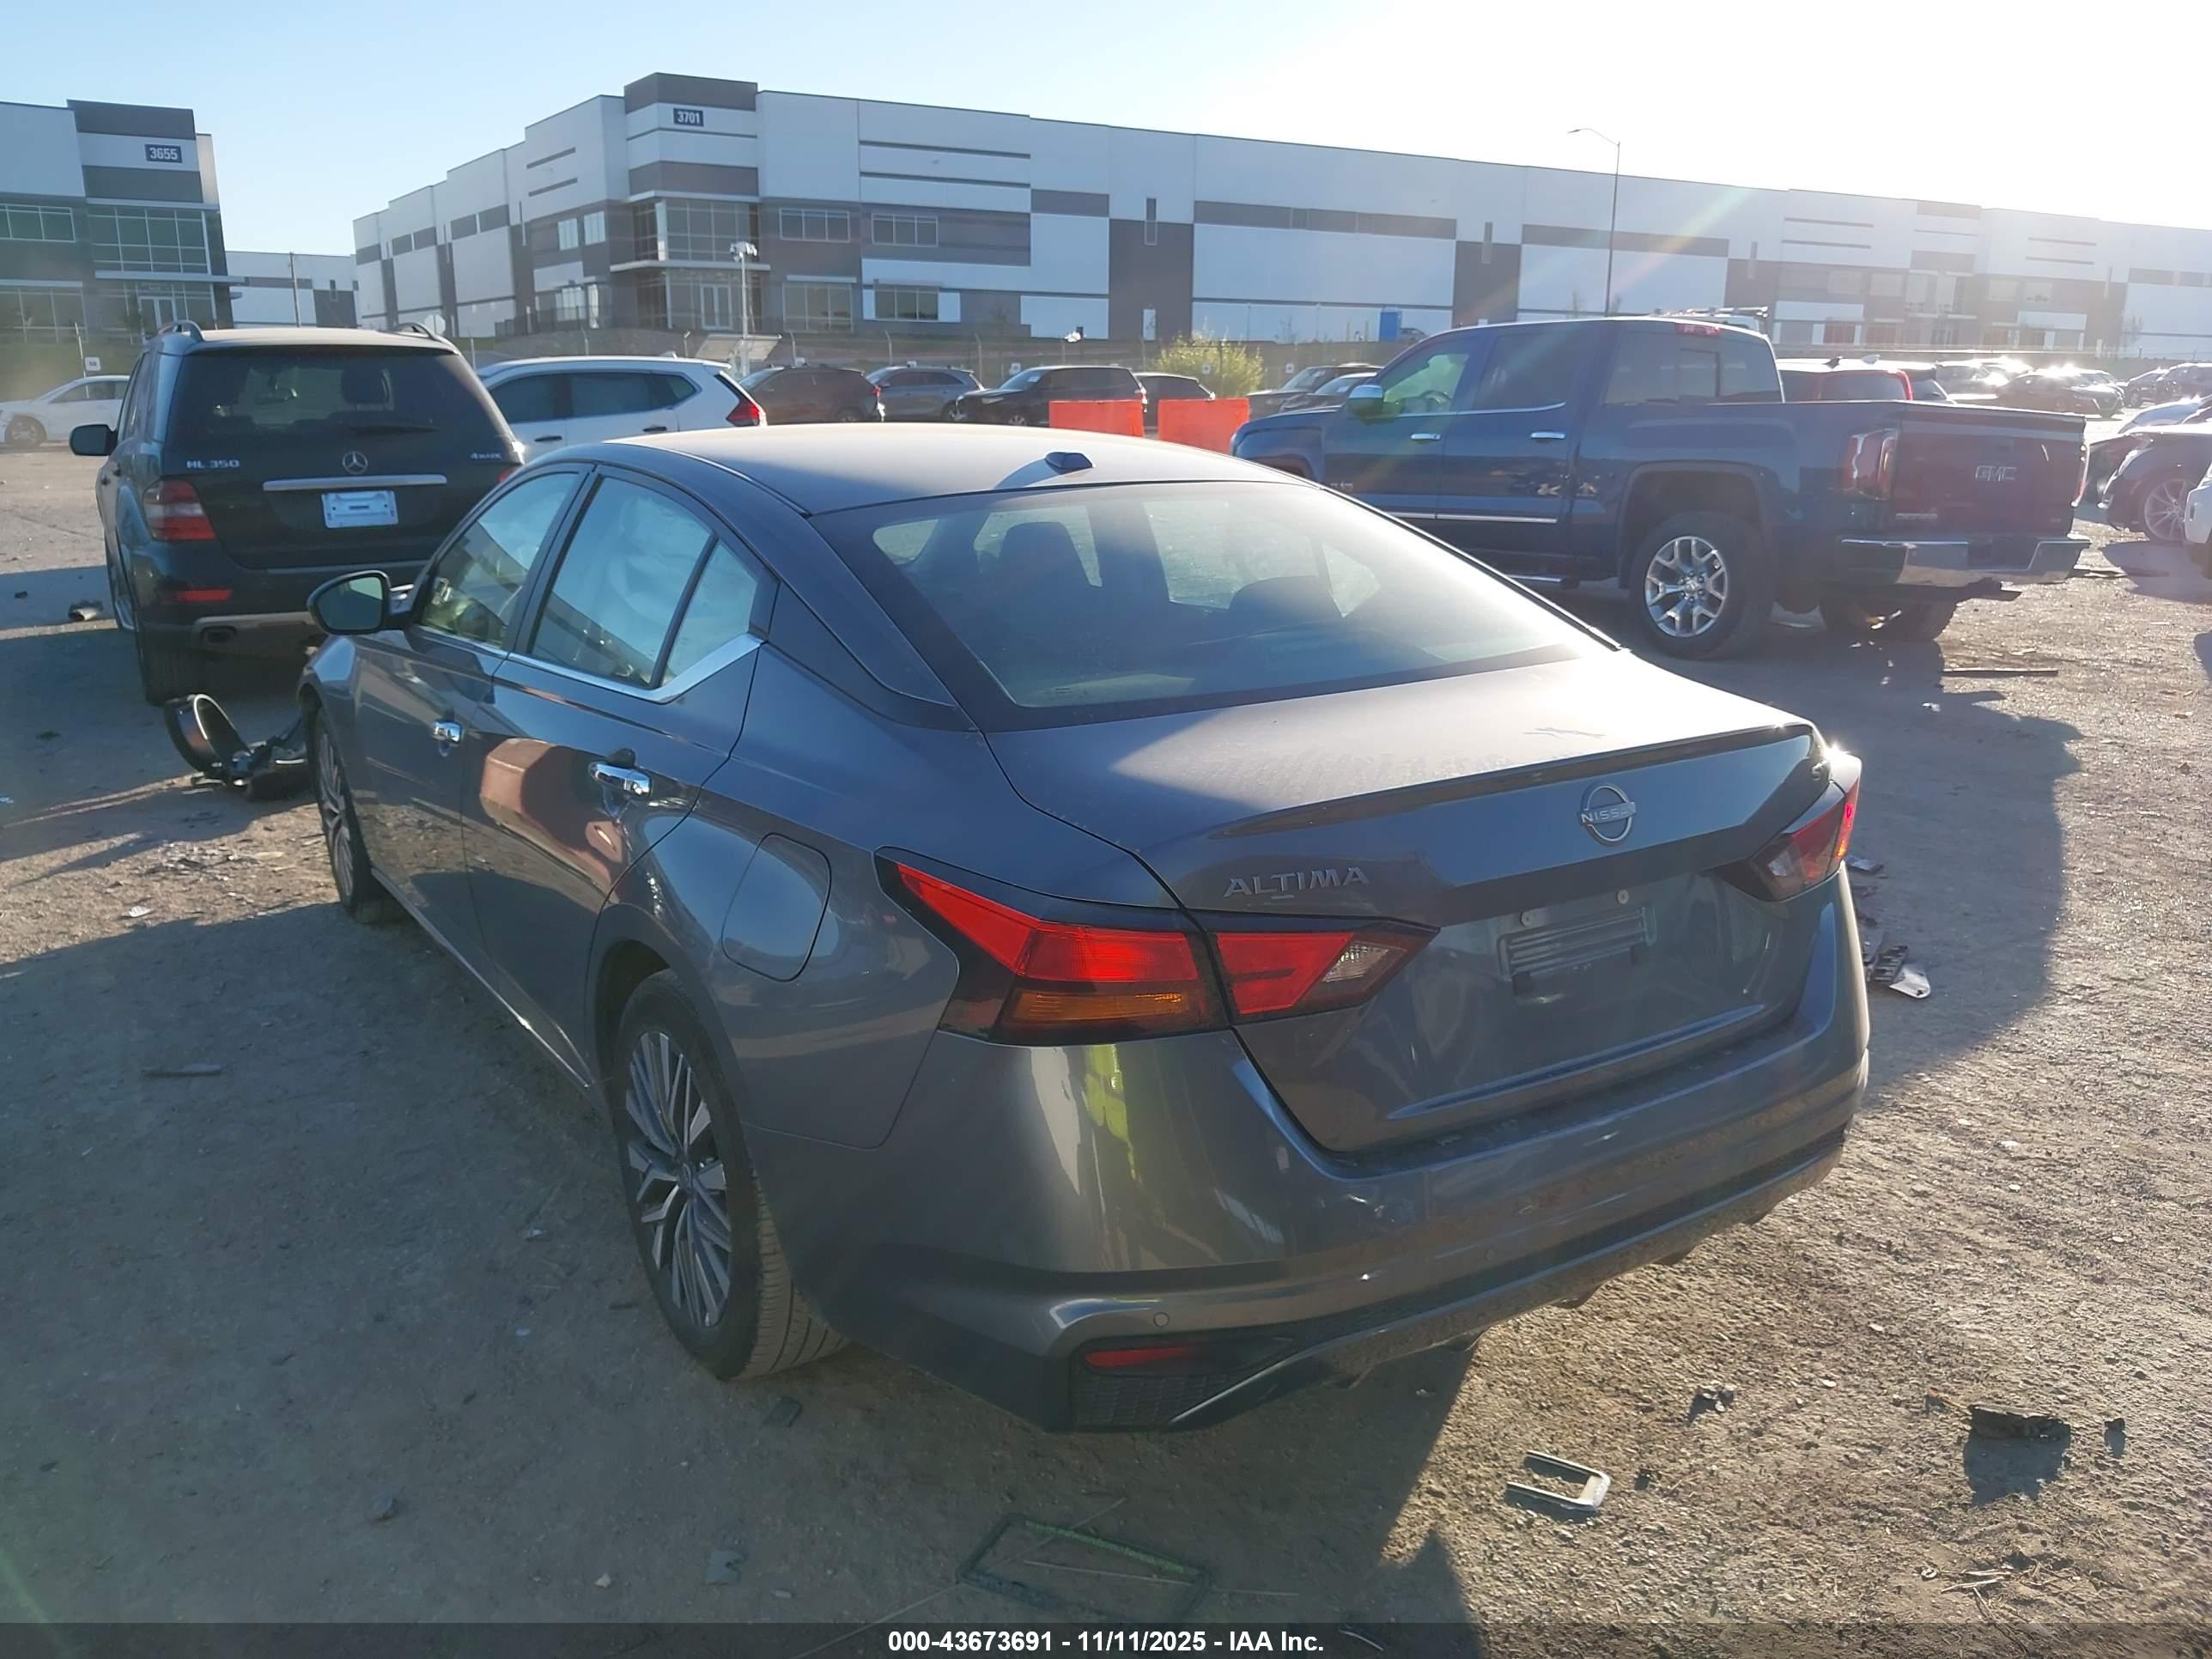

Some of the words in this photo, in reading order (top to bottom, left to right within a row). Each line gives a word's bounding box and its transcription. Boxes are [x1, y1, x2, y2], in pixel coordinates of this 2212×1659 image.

[678, 111, 700, 125] 3701
[149, 147, 179, 160] 3655
[186, 459, 205, 469] ML
[210, 459, 240, 468] 350
[1975, 465, 2017, 482] GMC
[1581, 805, 1634, 823] NISS
[1223, 866, 1370, 898] ALTIMA
